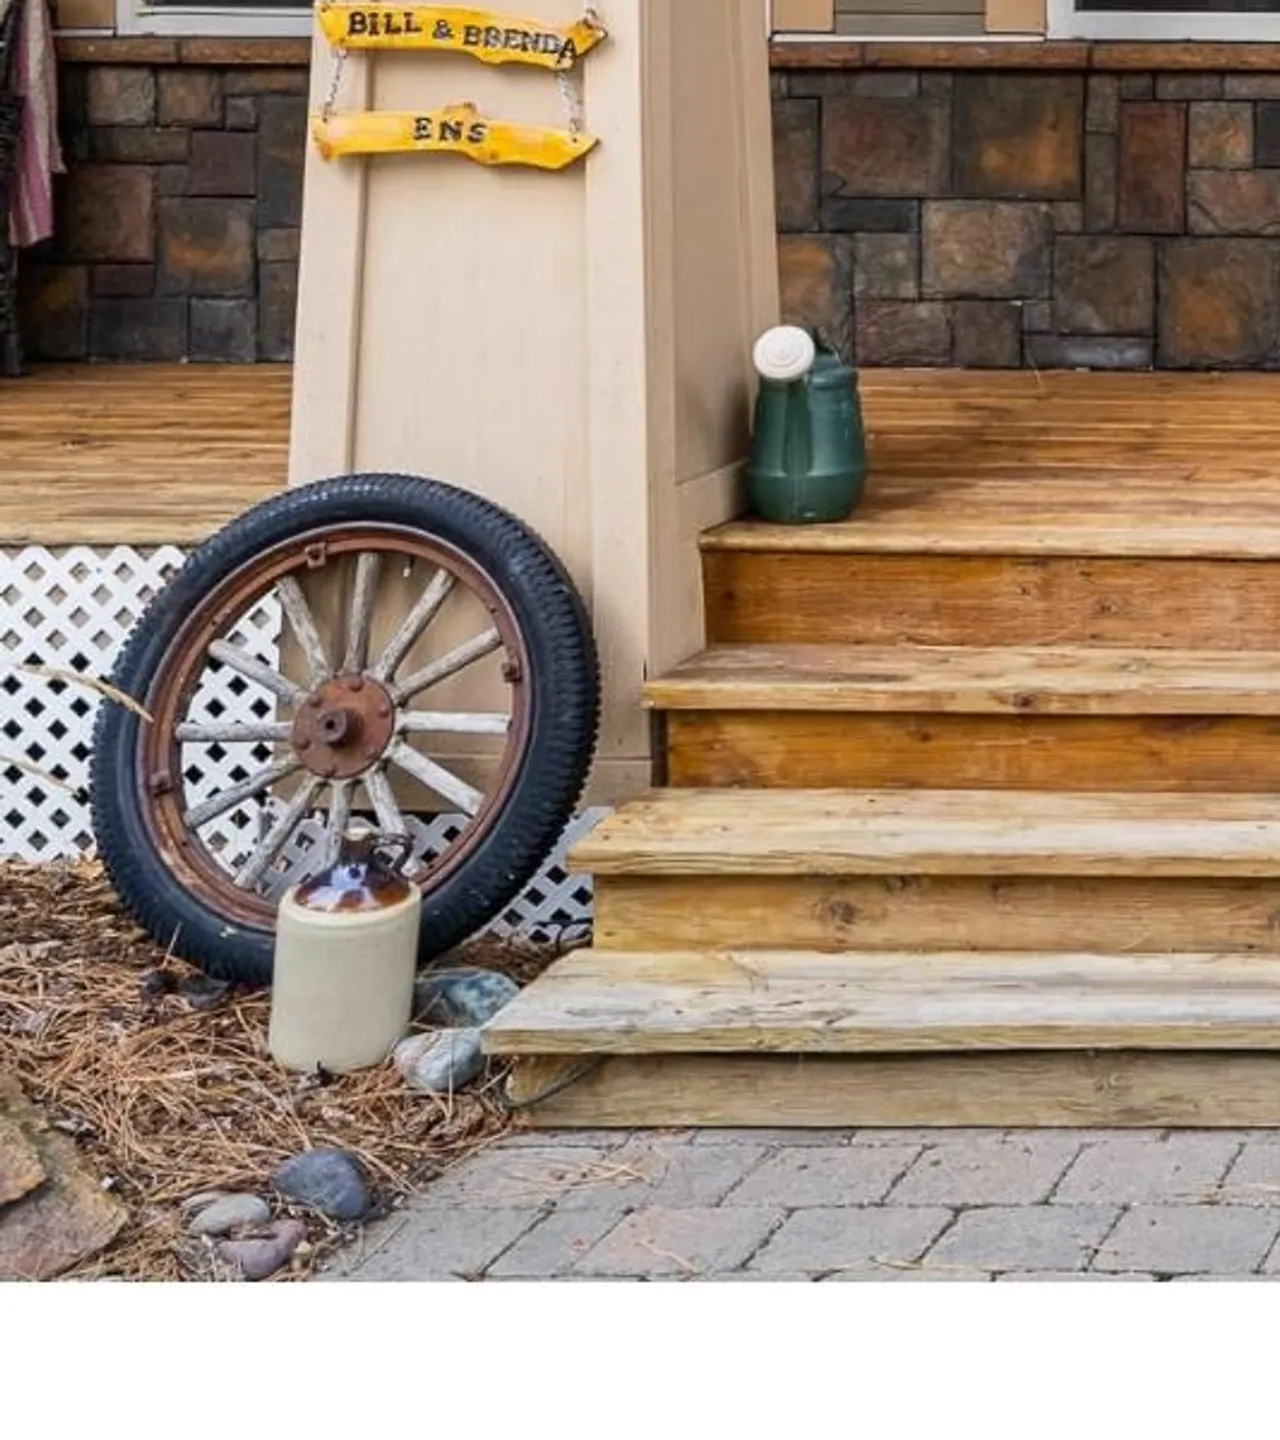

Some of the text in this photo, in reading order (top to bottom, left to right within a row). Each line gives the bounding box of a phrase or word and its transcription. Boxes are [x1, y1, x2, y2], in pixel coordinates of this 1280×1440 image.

[347, 11, 422, 35] BILL
[432, 19, 454, 40] &
[413, 117, 488, 144] ENS
